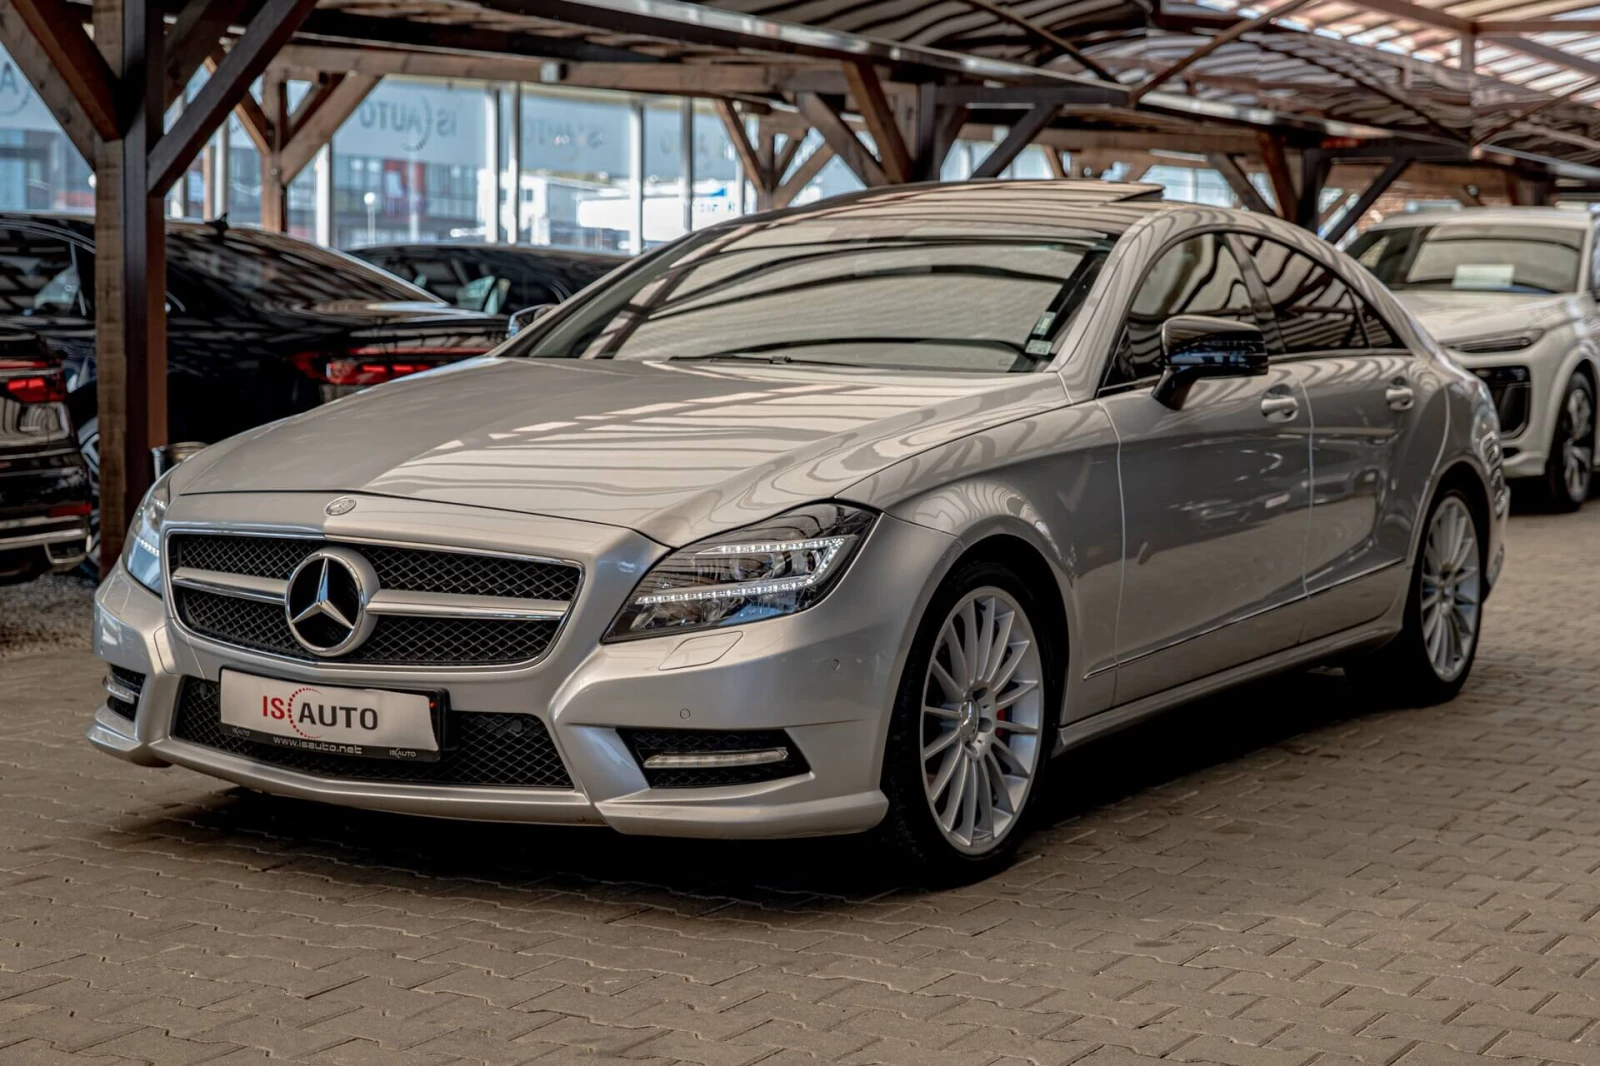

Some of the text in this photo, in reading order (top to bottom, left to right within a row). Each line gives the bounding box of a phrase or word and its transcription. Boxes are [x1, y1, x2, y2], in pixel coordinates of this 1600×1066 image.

[263, 696, 378, 730] IS AUTO
[272, 736, 363, 754] www.isauto.net
